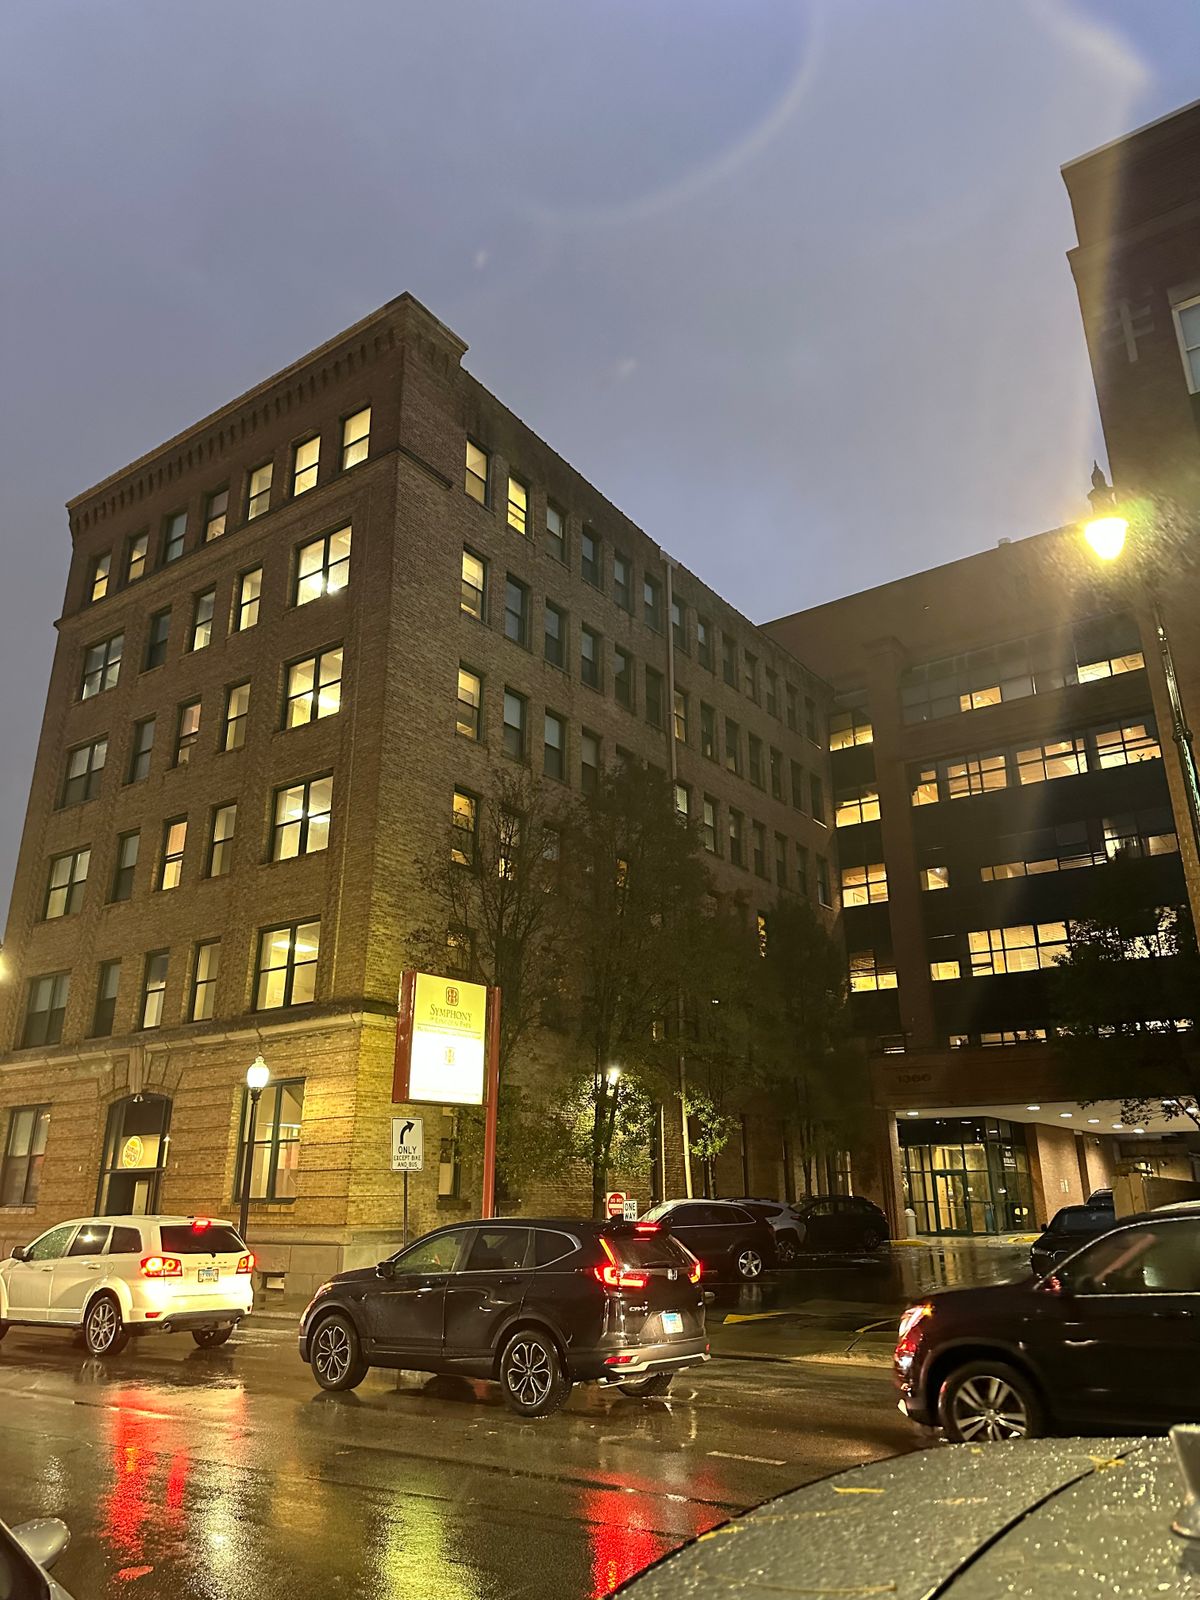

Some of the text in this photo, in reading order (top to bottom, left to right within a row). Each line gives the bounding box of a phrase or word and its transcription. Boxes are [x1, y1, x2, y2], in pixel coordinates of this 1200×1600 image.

[429, 1003, 473, 1022] SYMPHONY
[397, 1145, 416, 1154] ONLY
[624, 1202, 636, 1211] ONE
